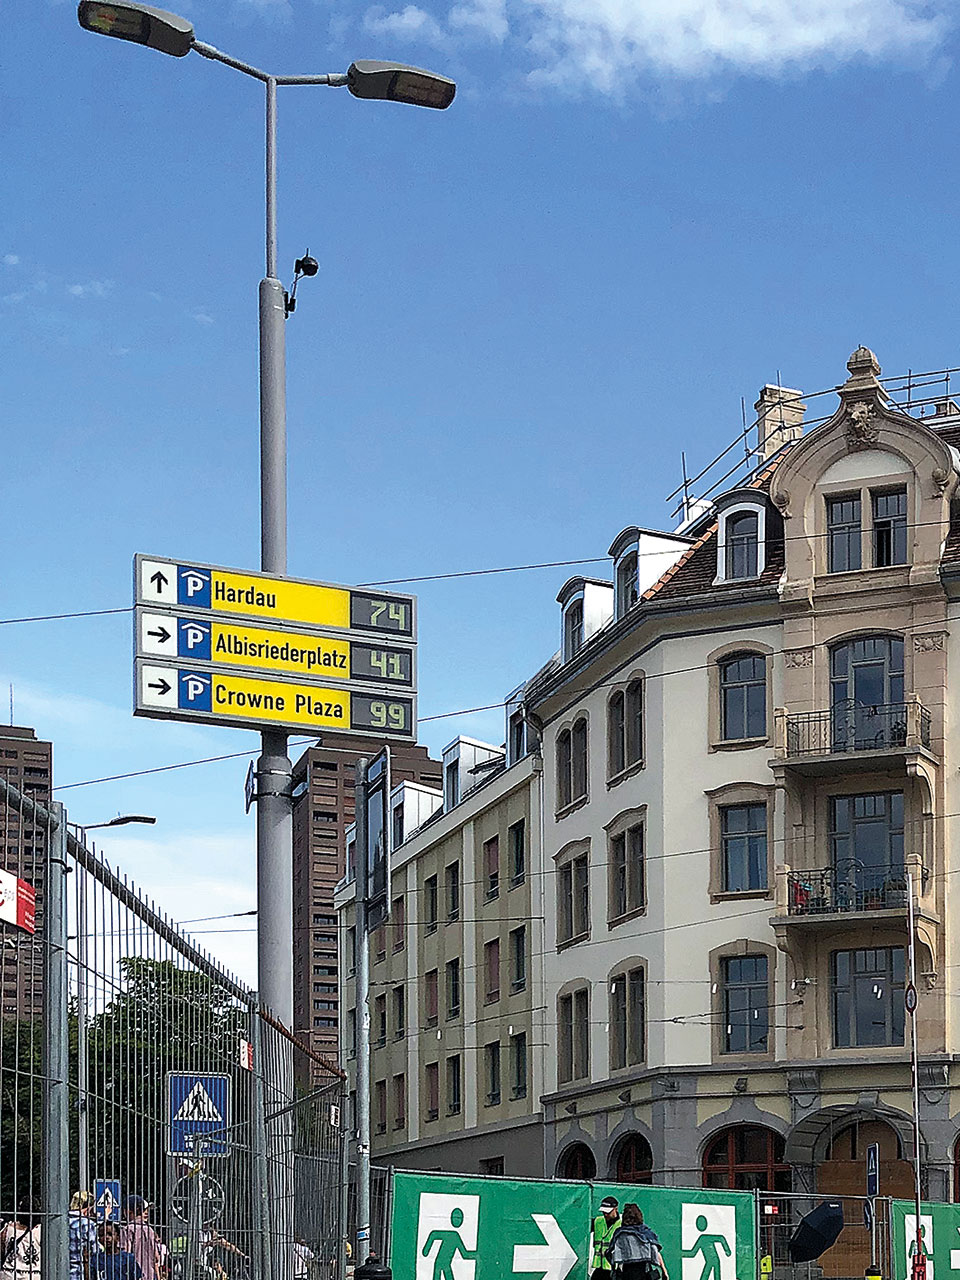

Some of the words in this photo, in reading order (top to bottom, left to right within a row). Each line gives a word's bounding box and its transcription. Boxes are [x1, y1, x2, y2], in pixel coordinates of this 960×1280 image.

[187, 576, 204, 597] P
[215, 580, 276, 609] Hardau
[370, 600, 405, 631] 74
[187, 628, 204, 649] P
[215, 633, 347, 669] Albisriederplatz
[370, 650, 405, 680] 41
[188, 680, 204, 701] P
[215, 684, 285, 711] Crowne
[295, 694, 344, 719] Plaza
[370, 701, 405, 730] 99
